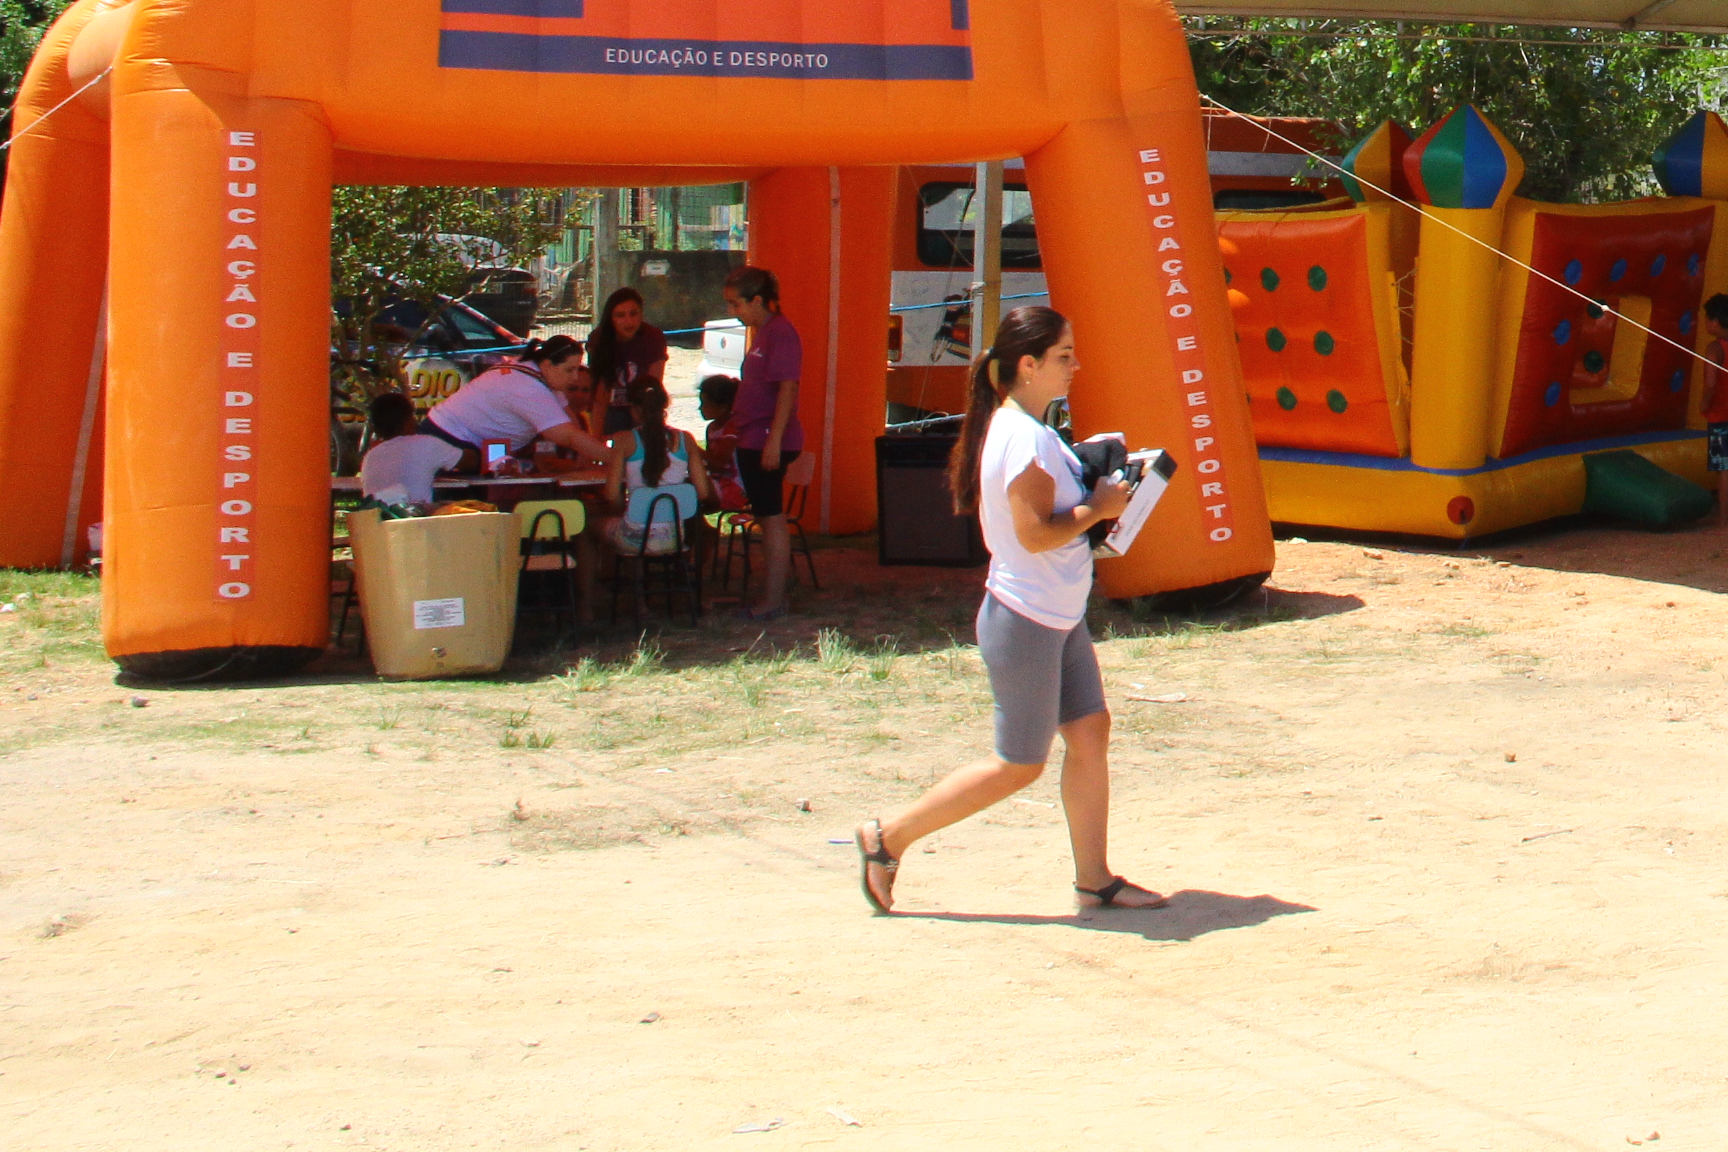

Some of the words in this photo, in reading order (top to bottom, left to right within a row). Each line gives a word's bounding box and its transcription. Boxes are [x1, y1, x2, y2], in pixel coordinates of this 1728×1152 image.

[605, 47, 708, 68] EDUCAÇÃO
[713, 51, 724, 66] E
[730, 51, 829, 68] DESPORTO
[226, 131, 257, 329] EDUCAÇÃO
[1139, 149, 1192, 318] EDUCAÇÃO
[227, 352, 253, 368] E
[1176, 336, 1197, 351] E
[218, 391, 253, 598] DESPORTO
[1182, 369, 1233, 542] DESPORTO
